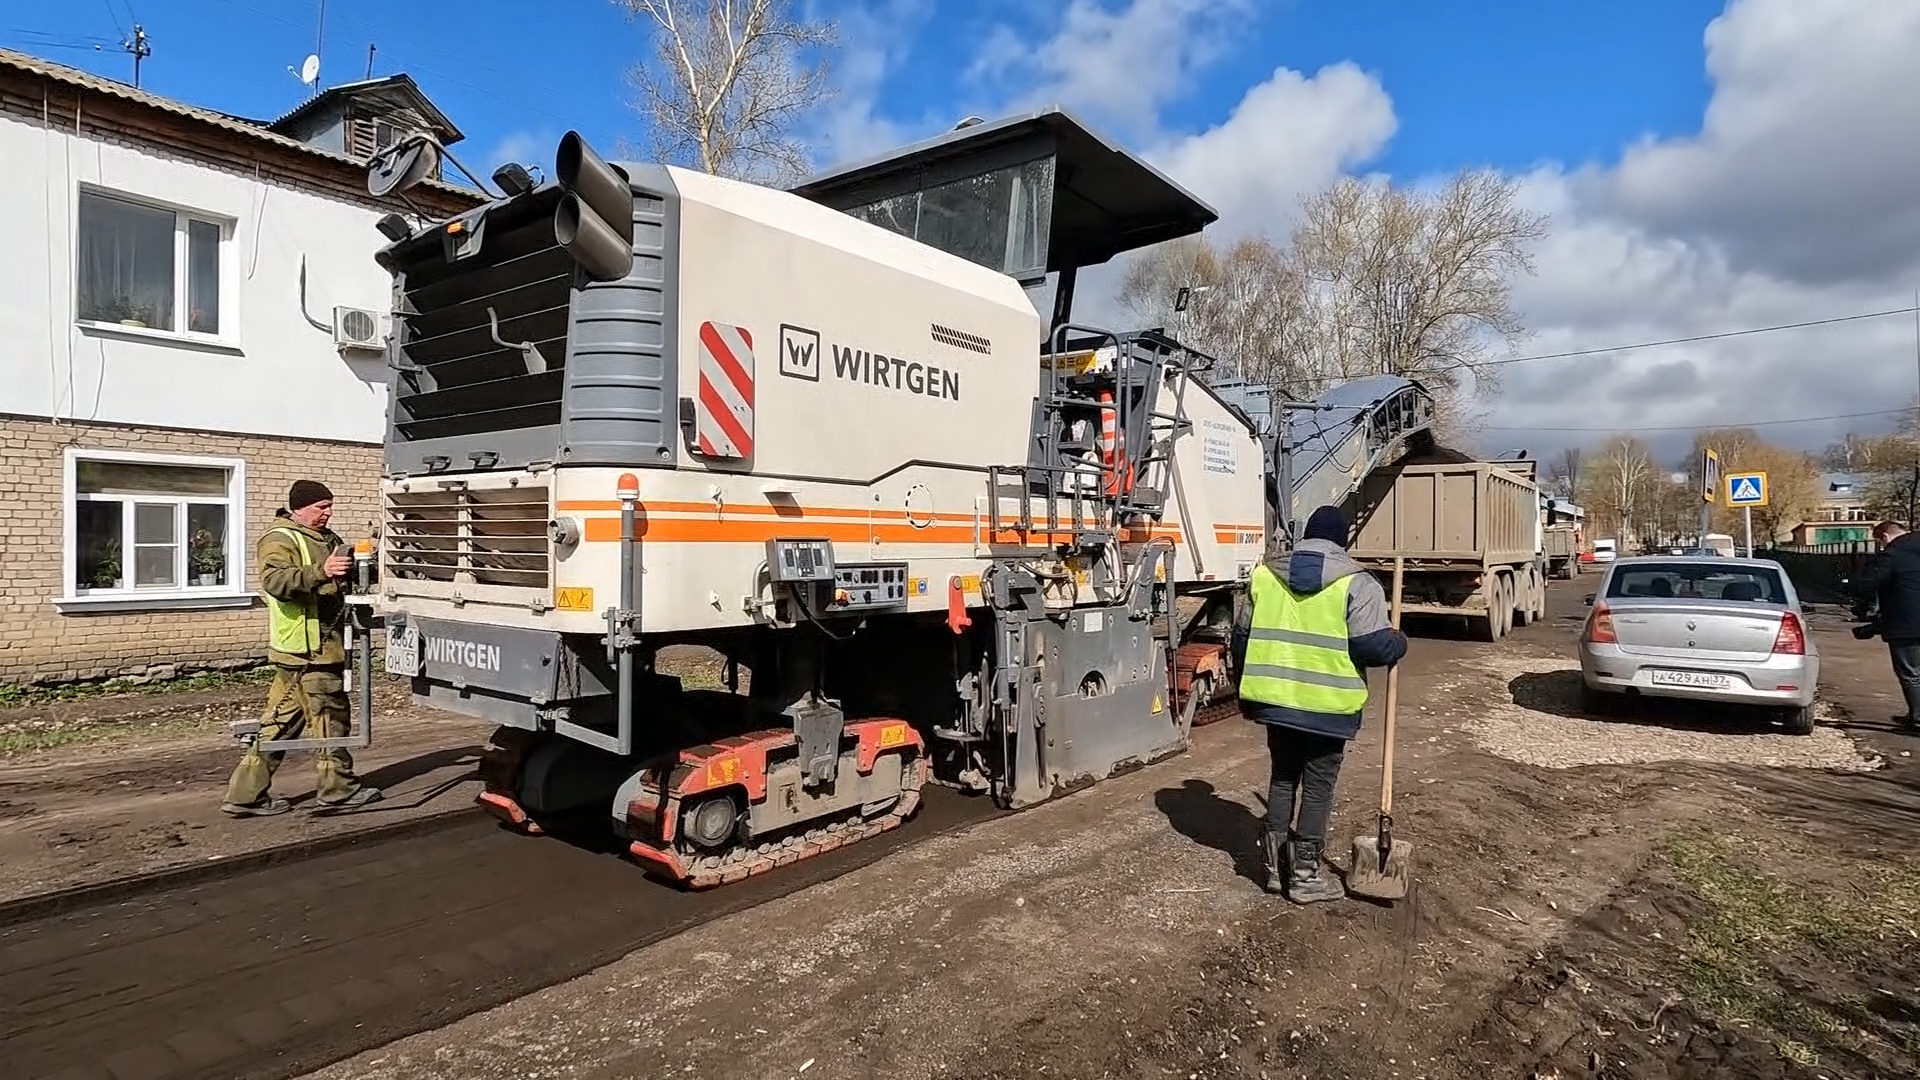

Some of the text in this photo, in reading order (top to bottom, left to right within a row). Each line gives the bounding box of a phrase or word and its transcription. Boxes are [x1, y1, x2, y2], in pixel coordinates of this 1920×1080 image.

[831, 343, 959, 401] WIRTGEN
[425, 636, 501, 672] WIRTGEN
[1713, 675, 1726, 683] 37
